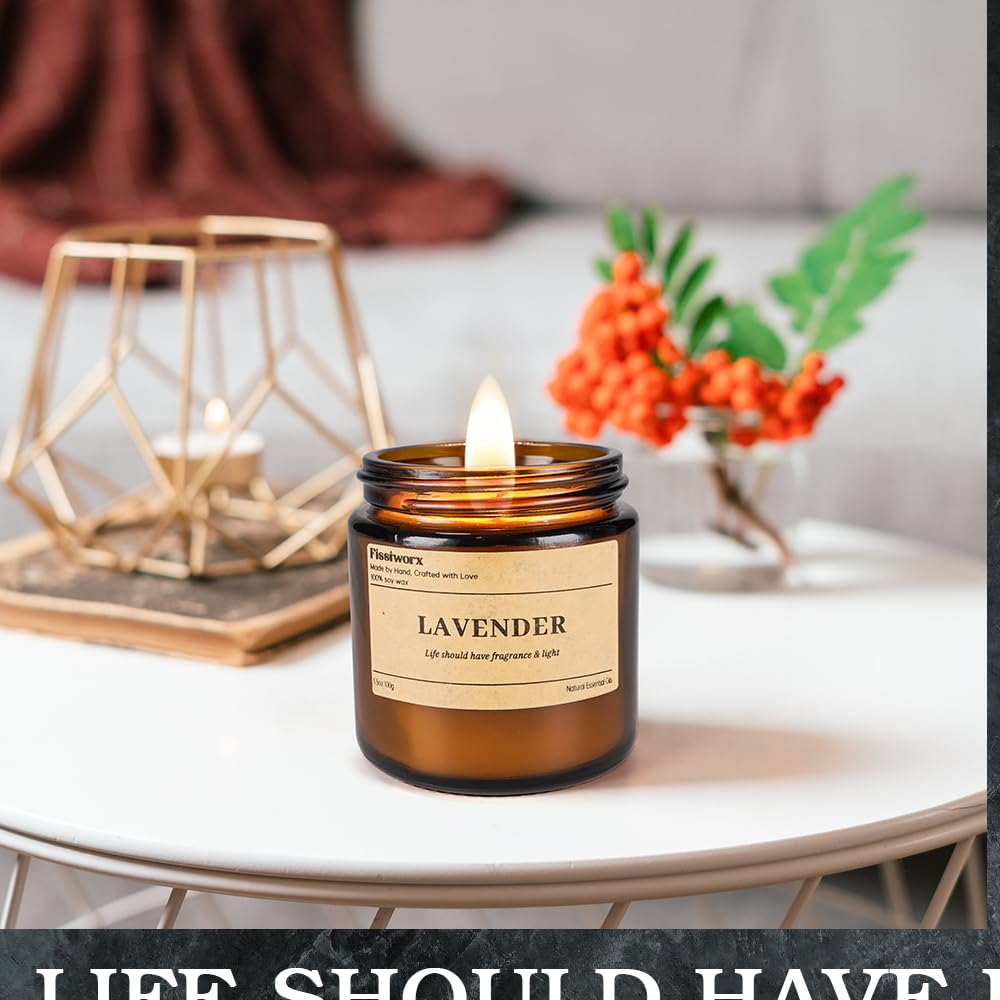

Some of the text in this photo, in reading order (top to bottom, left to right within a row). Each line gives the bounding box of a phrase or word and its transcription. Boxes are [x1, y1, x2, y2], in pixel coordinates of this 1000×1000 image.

[370, 547, 423, 566] Fissiworx
[370, 563, 384, 572] Made
[385, 566, 393, 574] by
[394, 568, 412, 576] Hand,
[414, 569, 440, 578] Crafted
[417, 615, 566, 638] LAVENDER
[425, 649, 560, 662] Life should have fragrance & light
